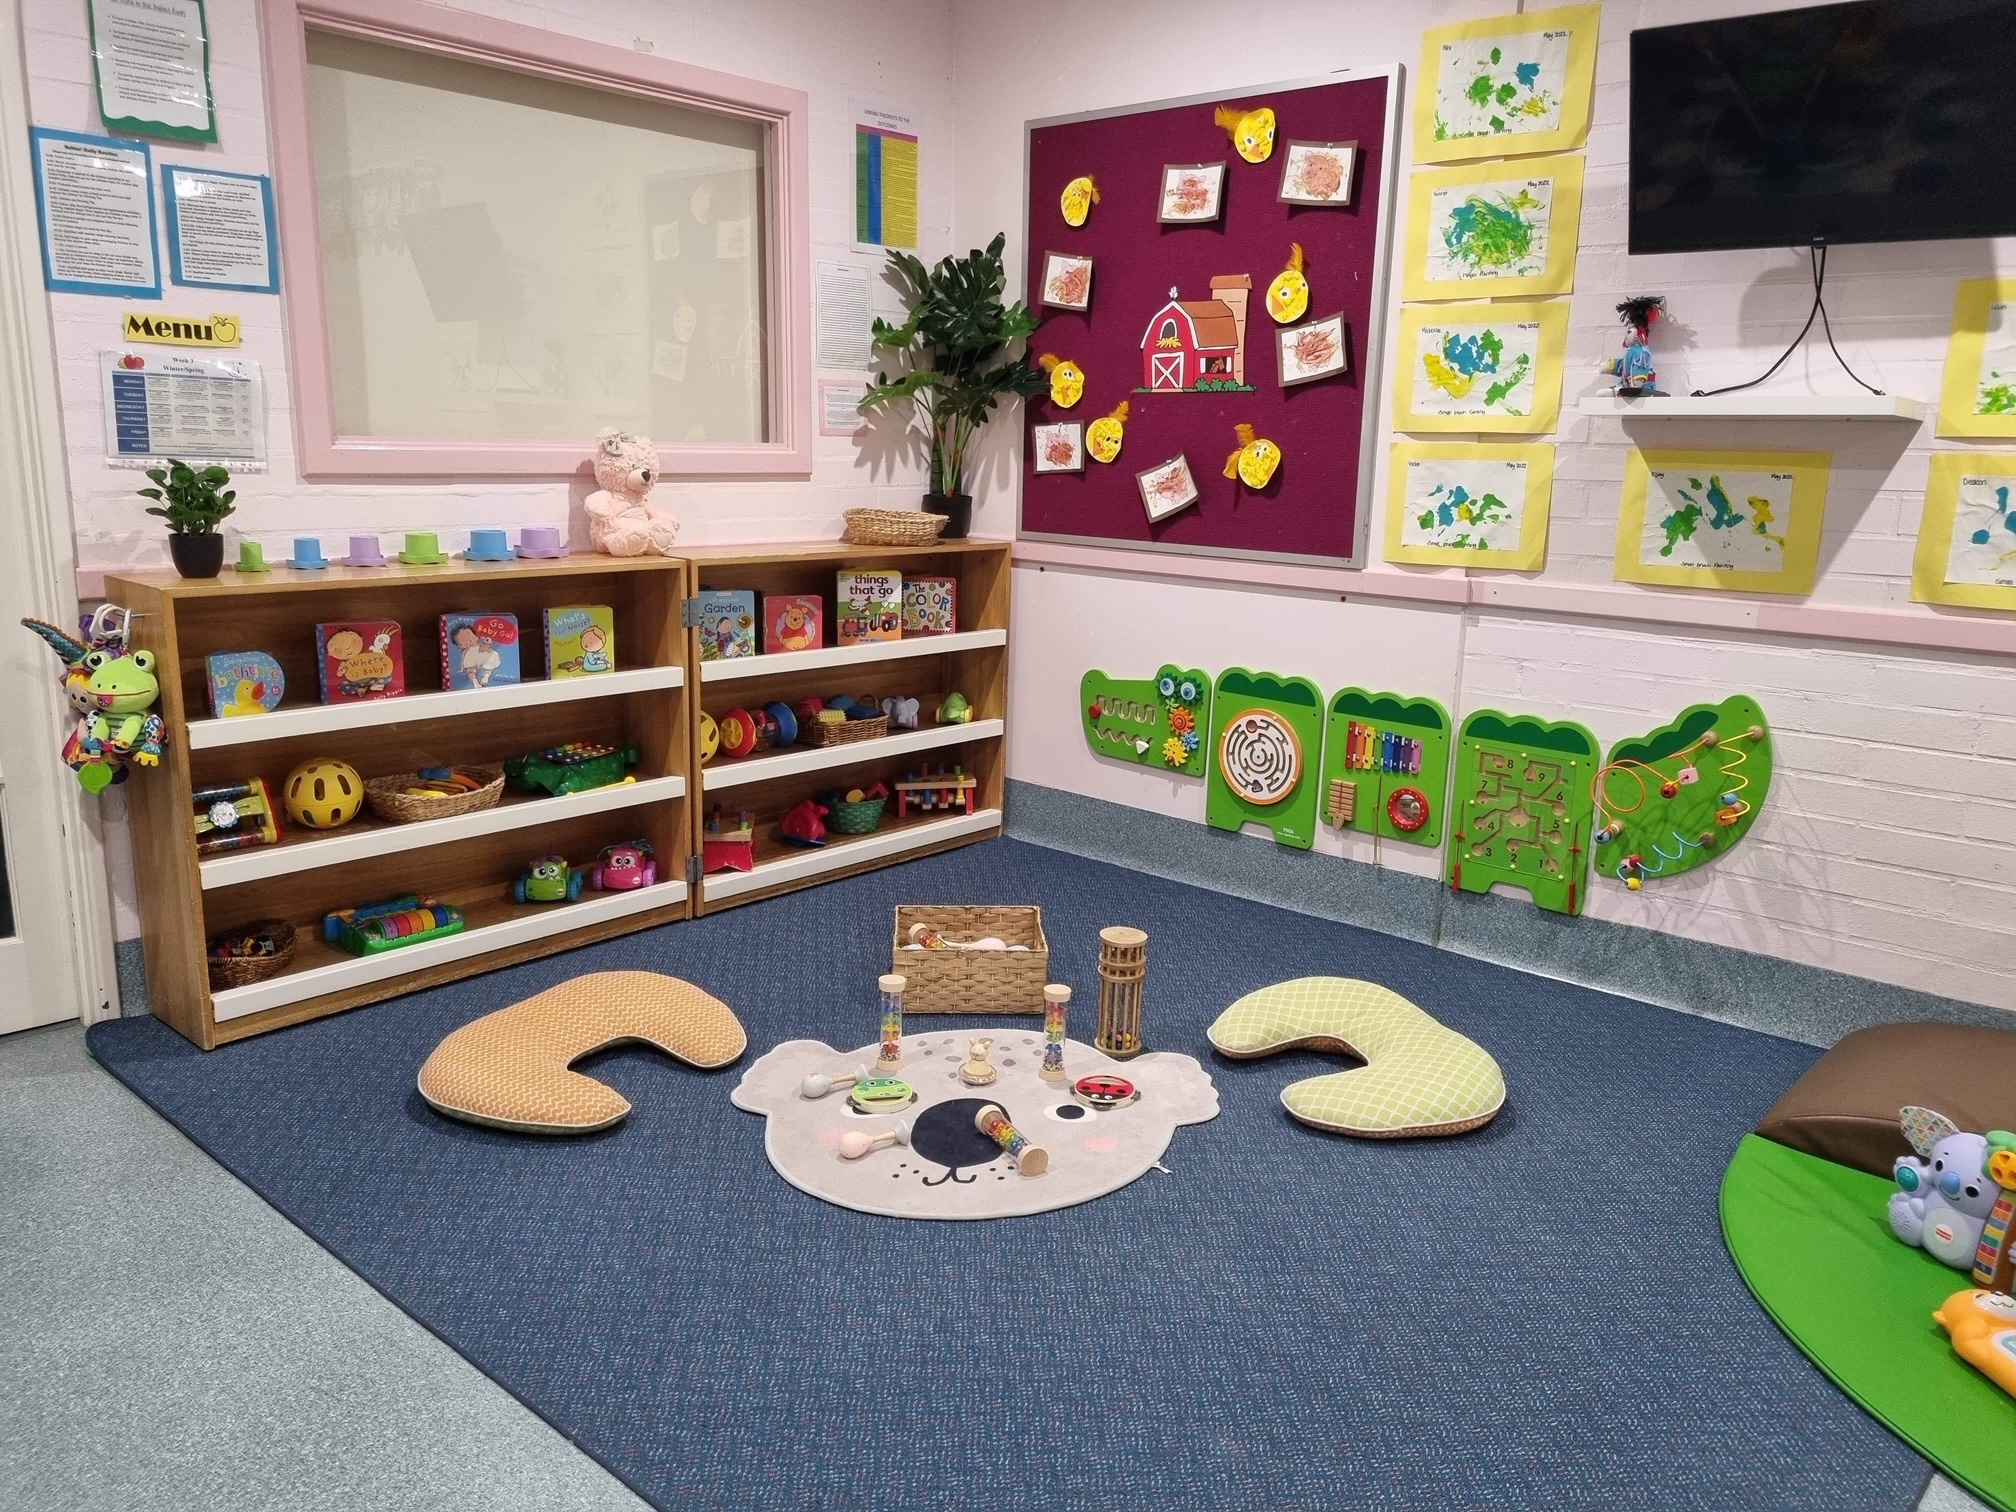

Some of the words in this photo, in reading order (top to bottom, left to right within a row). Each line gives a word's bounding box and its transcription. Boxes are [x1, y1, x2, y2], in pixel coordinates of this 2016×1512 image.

[128, 315, 213, 341] Menu
[163, 365, 205, 374] Winter/Spring
[855, 574, 889, 587] things
[850, 585, 875, 595] that
[878, 588, 893, 598] go
[913, 584, 926, 594] The
[906, 592, 949, 611] COLOR
[704, 603, 745, 613] Garden
[554, 612, 586, 627] What's
[907, 608, 945, 629] BOOK
[490, 620, 504, 629] Go
[568, 618, 590, 631] Noise?
[478, 625, 498, 637] Baby
[500, 630, 514, 640] Go!
[224, 657, 242, 667] Baby
[349, 656, 385, 668] Where
[364, 664, 388, 676] Baby?
[215, 665, 279, 688] bathtime
[1507, 760, 1513, 768] 8
[1539, 773, 1545, 782] 9
[1482, 780, 1488, 789] 7
[1557, 792, 1563, 801] 6
[1488, 822, 1494, 830] 4
[1553, 820, 1560, 829] 5
[1486, 848, 1491, 856] 3
[1511, 854, 1517, 862] 2
